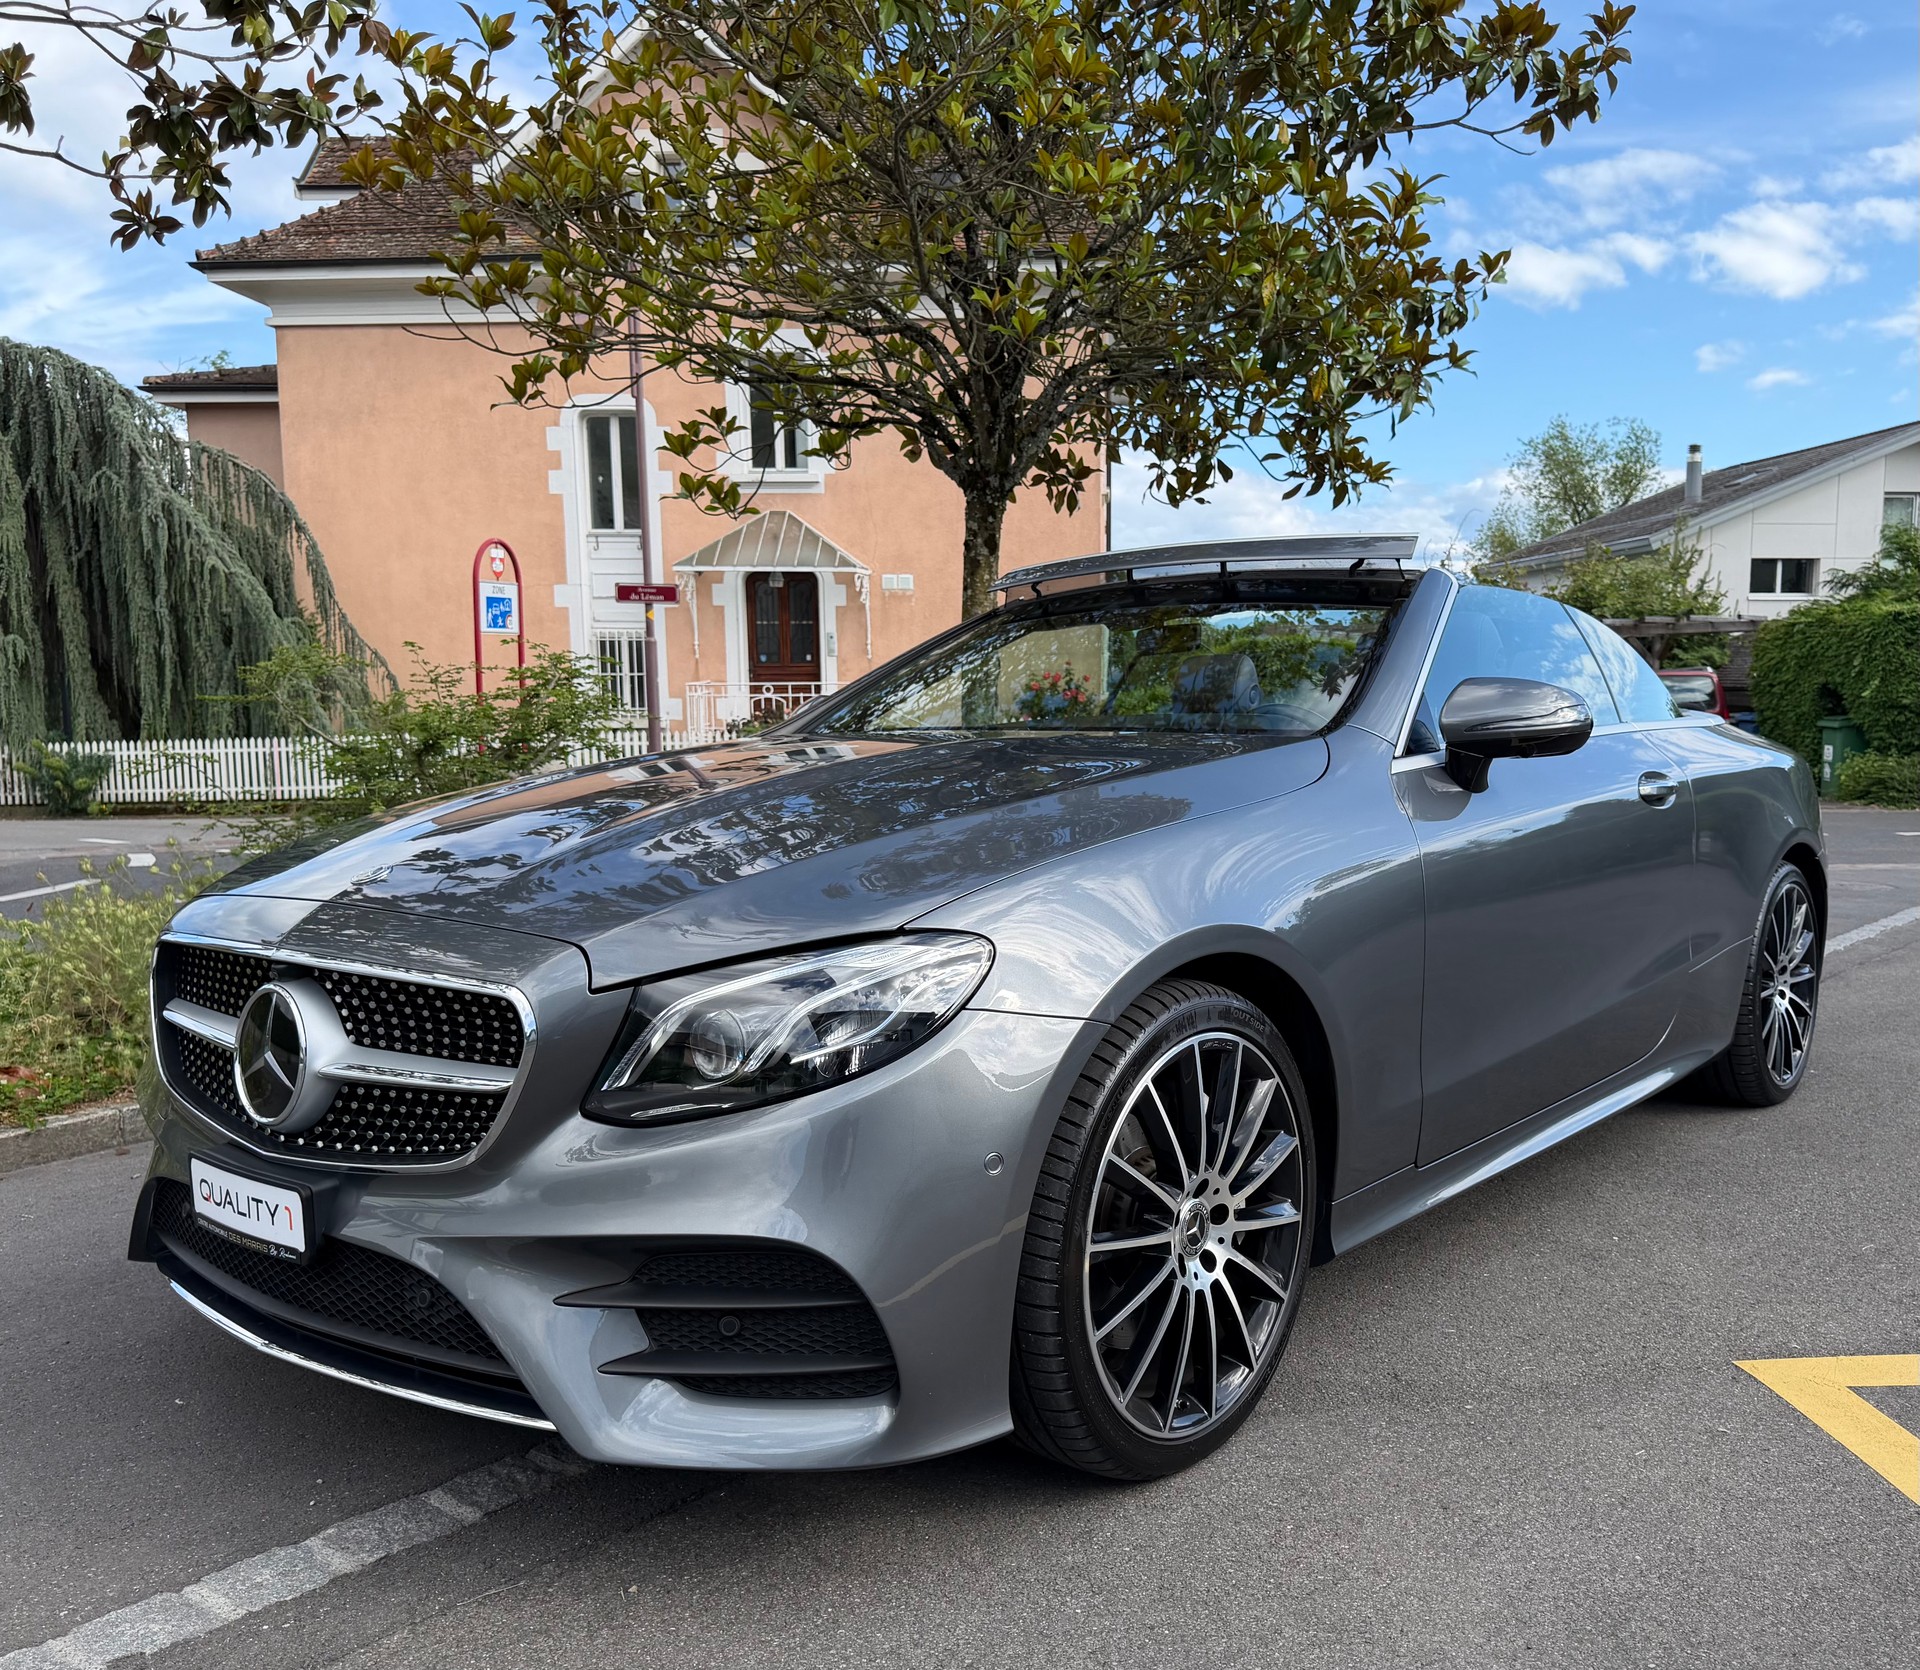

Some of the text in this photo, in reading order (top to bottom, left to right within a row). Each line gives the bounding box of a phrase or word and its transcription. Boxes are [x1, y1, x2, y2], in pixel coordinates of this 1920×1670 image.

[492, 585, 506, 595] ZONE
[629, 592, 665, 601] du Léman
[1233, 1009, 1266, 1033] OUTSIDE
[199, 1178, 293, 1231] QUALITY 1
[228, 1232, 241, 1244] DES
[242, 1237, 269, 1253] MARAIS
